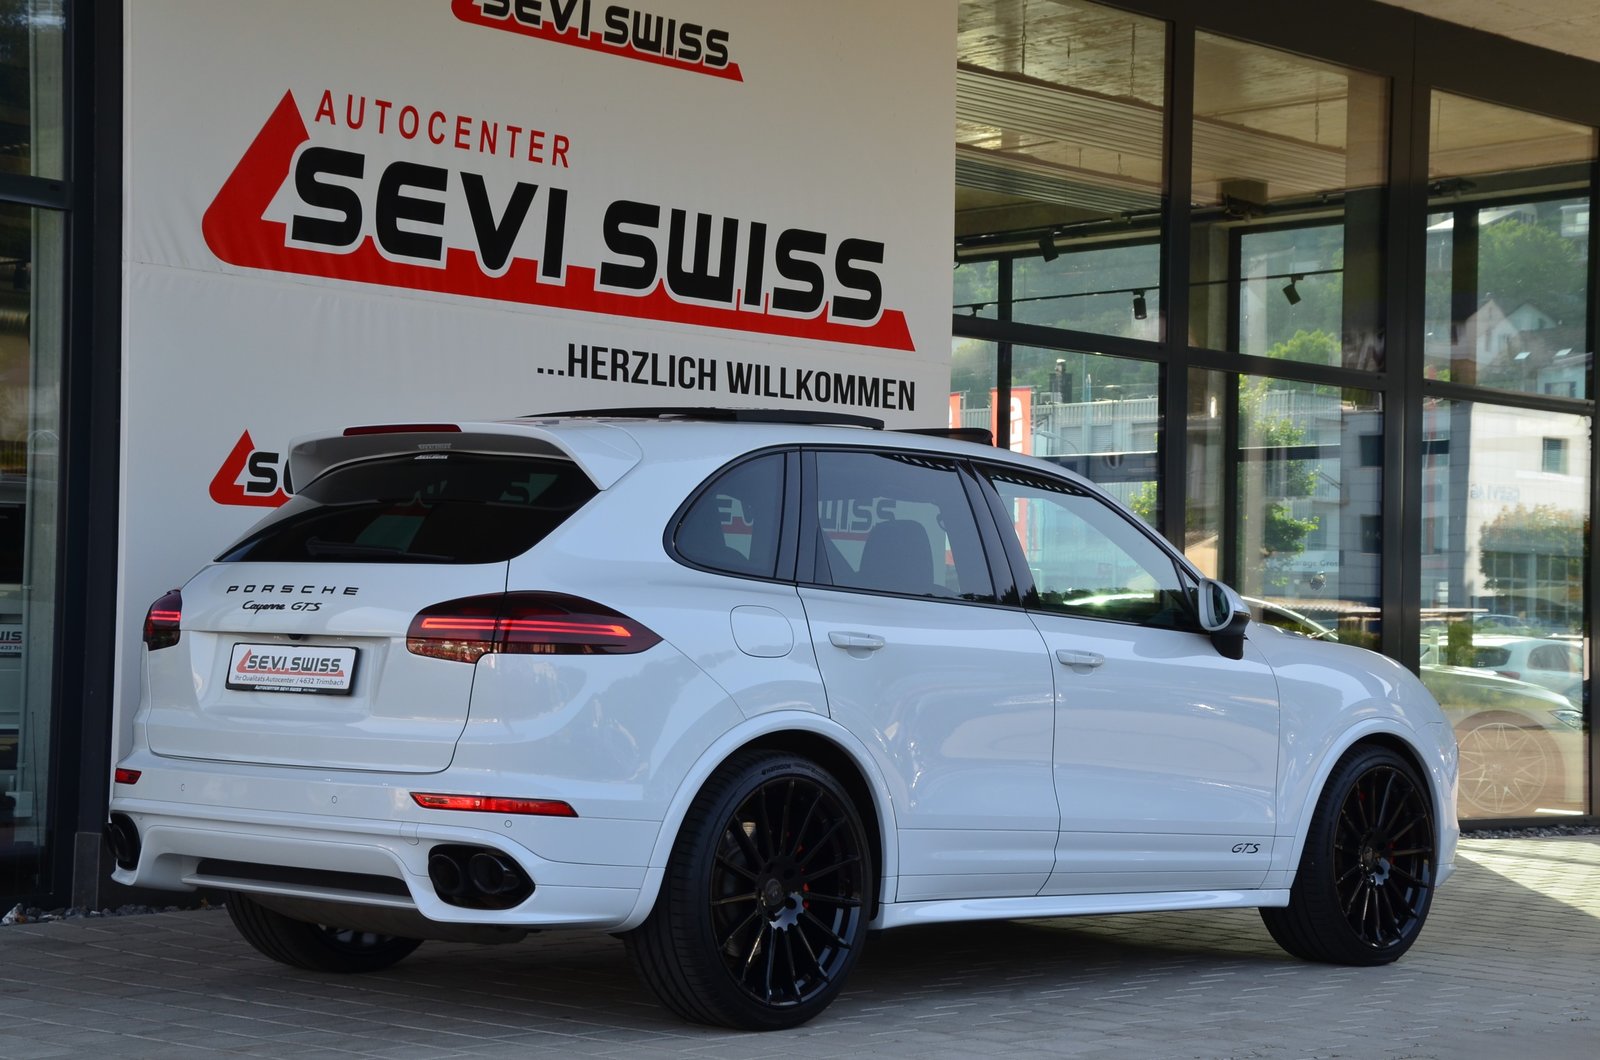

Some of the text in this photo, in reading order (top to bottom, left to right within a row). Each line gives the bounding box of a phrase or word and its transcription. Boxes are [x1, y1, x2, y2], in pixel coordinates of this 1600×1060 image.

[603, 5, 729, 68] SWISS
[314, 89, 570, 168] AUTOCENTER
[291, 146, 885, 321] SEVI SWISS
[537, 343, 915, 411] ...HERZLICH WILLKOMMEN
[226, 584, 359, 596] PORSCHE
[242, 600, 322, 614] Cayenne GTS
[247, 655, 341, 673] SEVI SWISS
[316, 678, 344, 686] Trimbach
[1231, 842, 1261, 854] GTS
